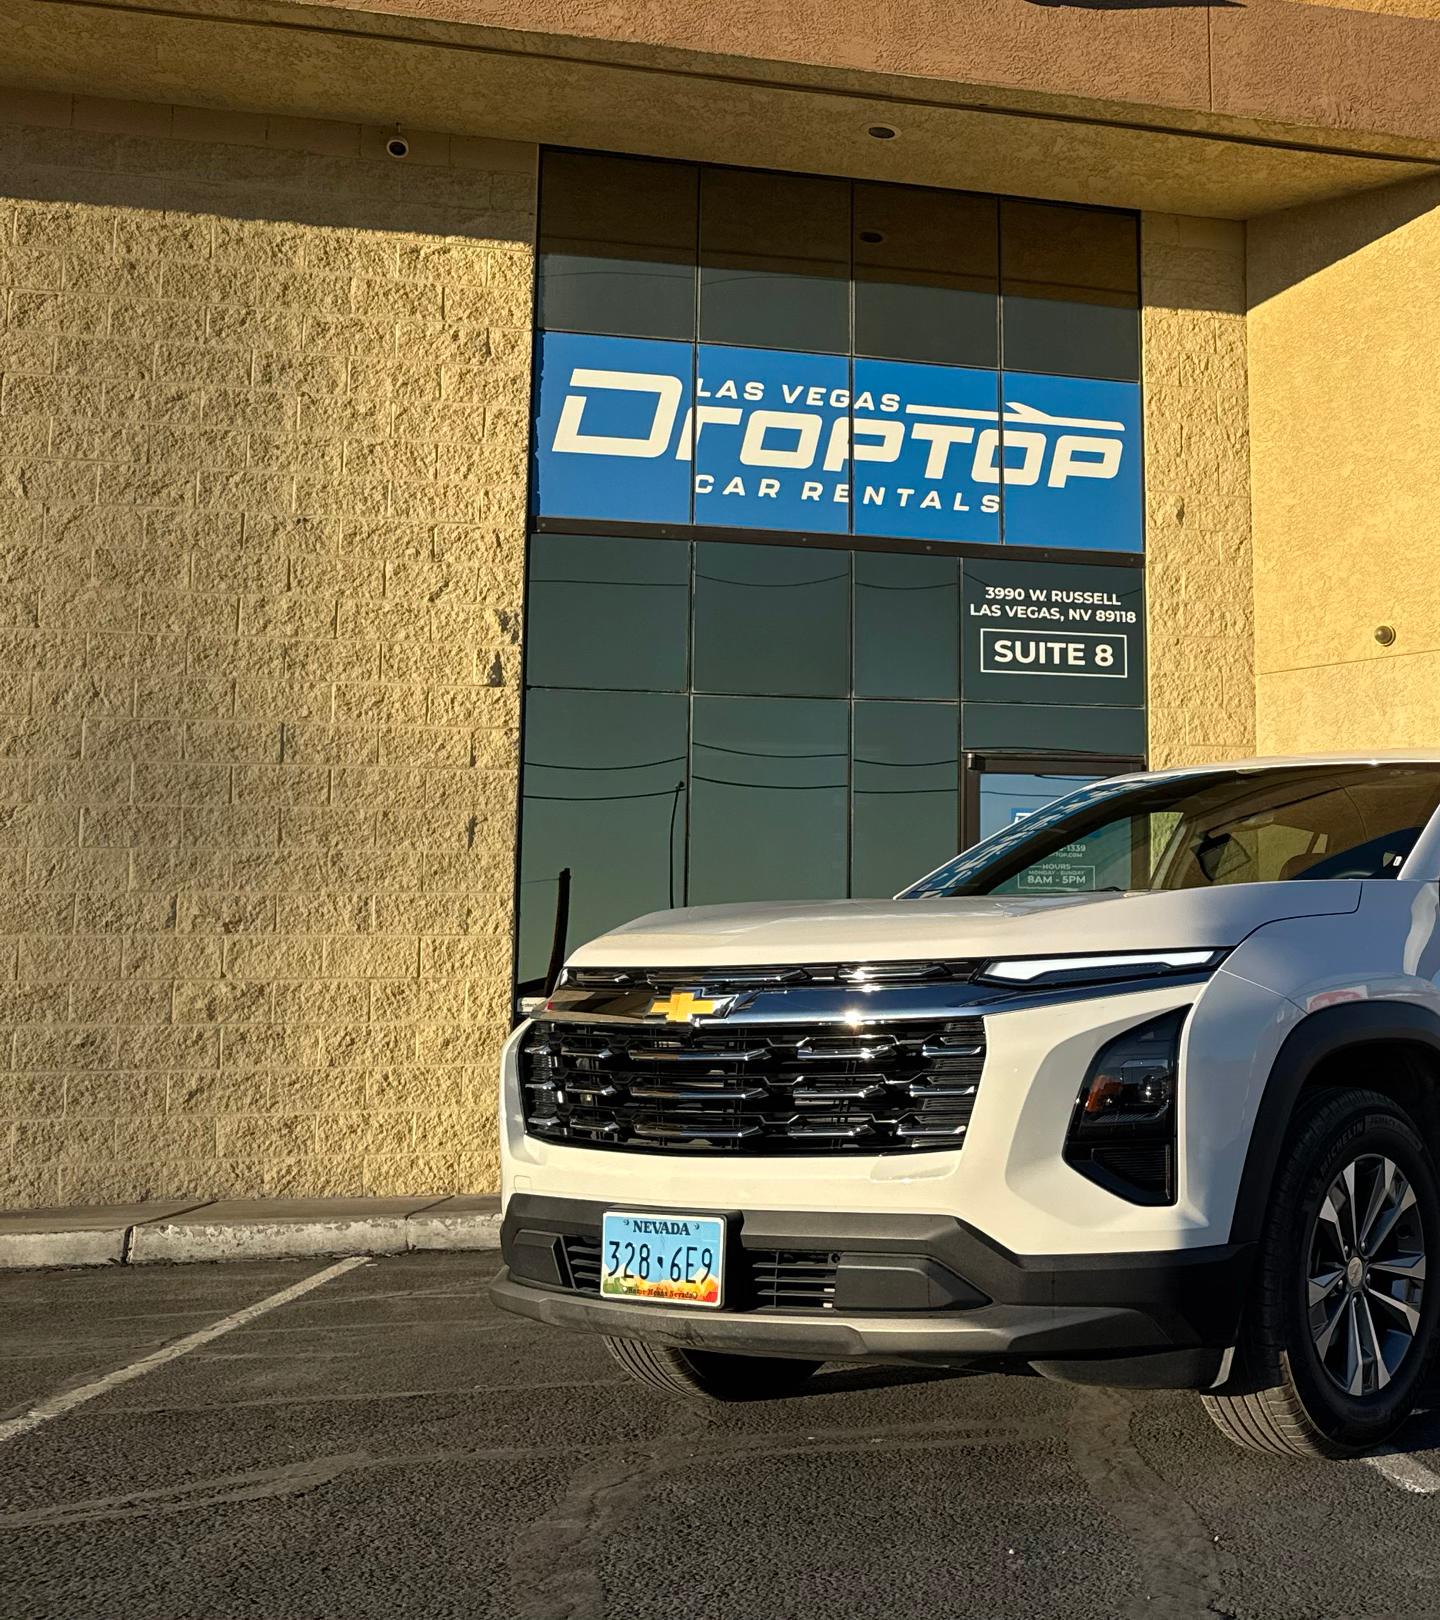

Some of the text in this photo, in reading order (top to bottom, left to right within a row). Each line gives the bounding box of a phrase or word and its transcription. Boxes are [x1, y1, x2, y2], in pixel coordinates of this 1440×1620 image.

[696, 377, 901, 413] LAS VEGAS
[695, 474, 1001, 514] CAR RENTALS
[985, 586, 1025, 601] 3990
[1051, 590, 1122, 606] RUSSELL
[970, 603, 1137, 624] LAS VEGAS, NV 89118
[993, 639, 1114, 667] SUITE 8
[1027, 875, 1053, 884] 8AM
[1062, 875, 1086, 884] 5PM
[1319, 1117, 1366, 1178] MICHELIN
[633, 1220, 691, 1236] NEVADA
